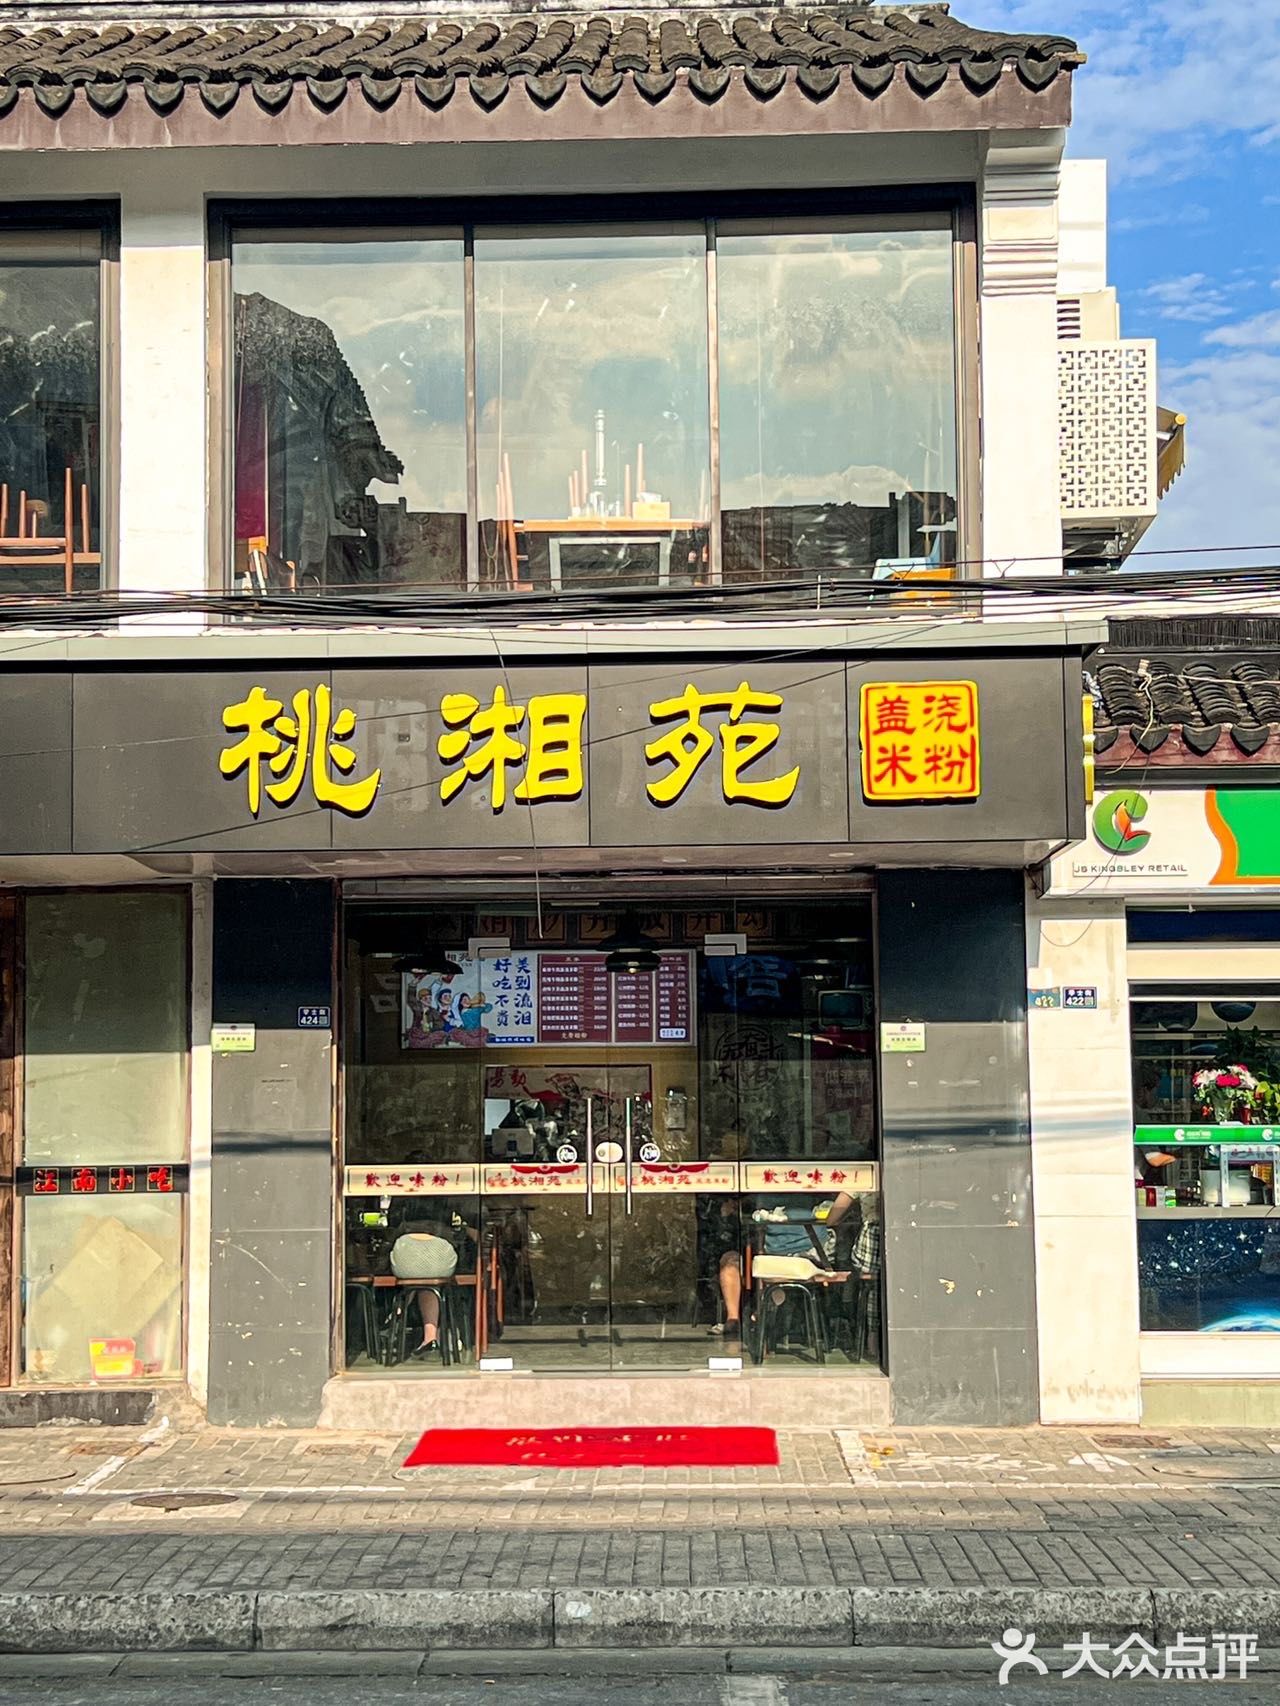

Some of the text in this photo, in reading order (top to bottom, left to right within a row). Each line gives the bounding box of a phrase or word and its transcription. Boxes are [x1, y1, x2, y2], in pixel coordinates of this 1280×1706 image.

[873, 693, 968, 736] 盖浇
[219, 683, 801, 813] 桃湘苑
[874, 743, 970, 787] 米粉
[1091, 864, 1145, 873] KINGSLEY
[1148, 864, 1188, 872] RETAIL
[493, 958, 512, 1026] 好吃不贵
[514, 957, 533, 1026] 美到流泪
[300, 1015, 328, 1025] 424
[35, 1166, 173, 1192] 江南小吃
